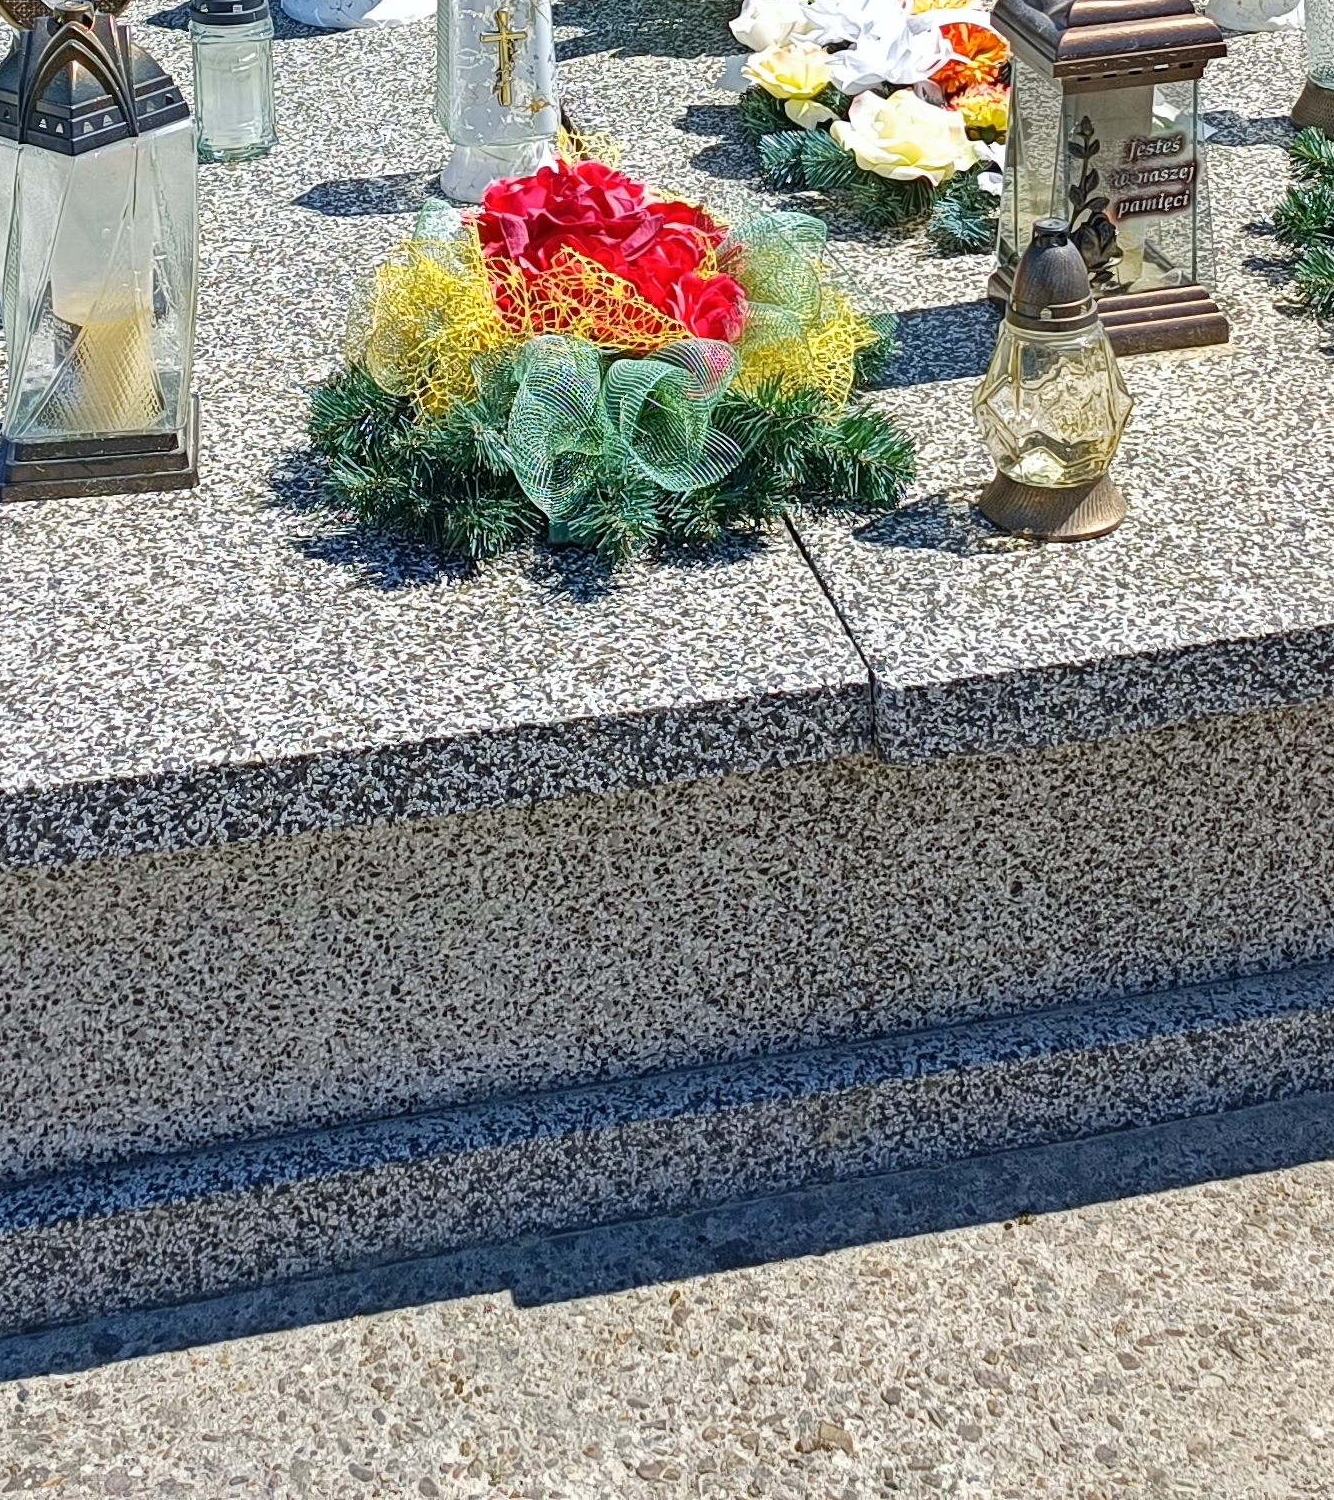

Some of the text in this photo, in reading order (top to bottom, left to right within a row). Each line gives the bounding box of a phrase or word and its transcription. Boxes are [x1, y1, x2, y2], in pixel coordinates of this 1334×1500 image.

[1128, 135, 1182, 162] Jesteś
[1137, 162, 1195, 184] naszej
[1118, 190, 1190, 218] pamięci
